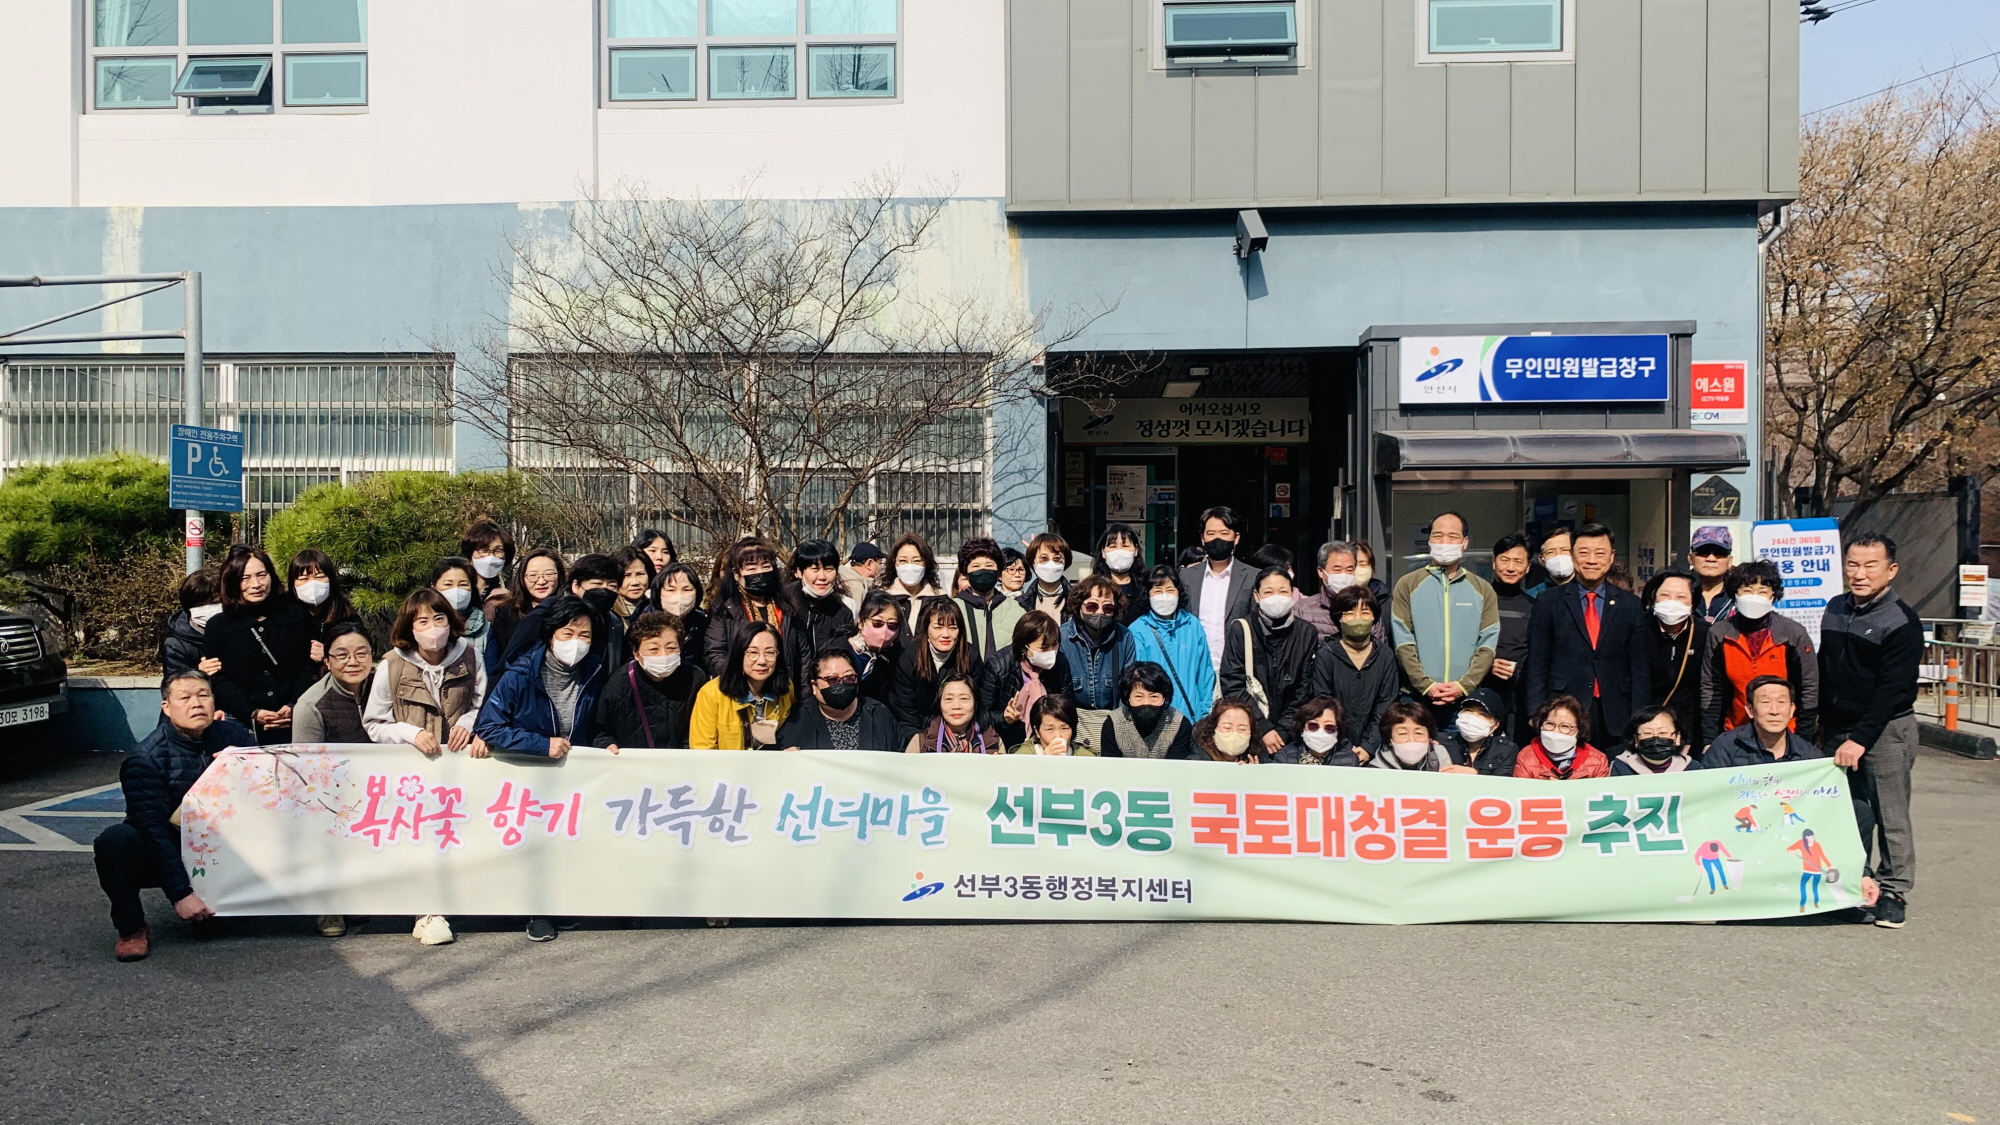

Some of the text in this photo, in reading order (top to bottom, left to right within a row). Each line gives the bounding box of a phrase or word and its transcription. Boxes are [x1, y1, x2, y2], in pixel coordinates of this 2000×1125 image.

[1505, 357, 1656, 379] 무인민원발급창구
[1424, 385, 1457, 394] 안산시
[1695, 377, 1735, 393] 에스원
[1179, 402, 1262, 416] 어서오십시오
[1690, 412, 1720, 421] ECOM
[177, 427, 238, 444] 장애인 전용주차구역
[1136, 419, 1307, 438] 정성껏 모시겠습니다
[187, 442, 202, 475] P
[1713, 496, 1739, 516] 47
[1771, 536, 1821, 545] 24시간 365일
[1760, 545, 1835, 558] 무인민원발급기
[1801, 559, 1831, 573] 안내
[22, 706, 45, 721] 3198
[1812, 785, 1842, 799] 안산
[350, 774, 1685, 861] 복사꽃 향기 가득한 선녀마을 선부3동 국토대청결 운동 추진
[952, 873, 1193, 904] 선부3동행정복지센터
